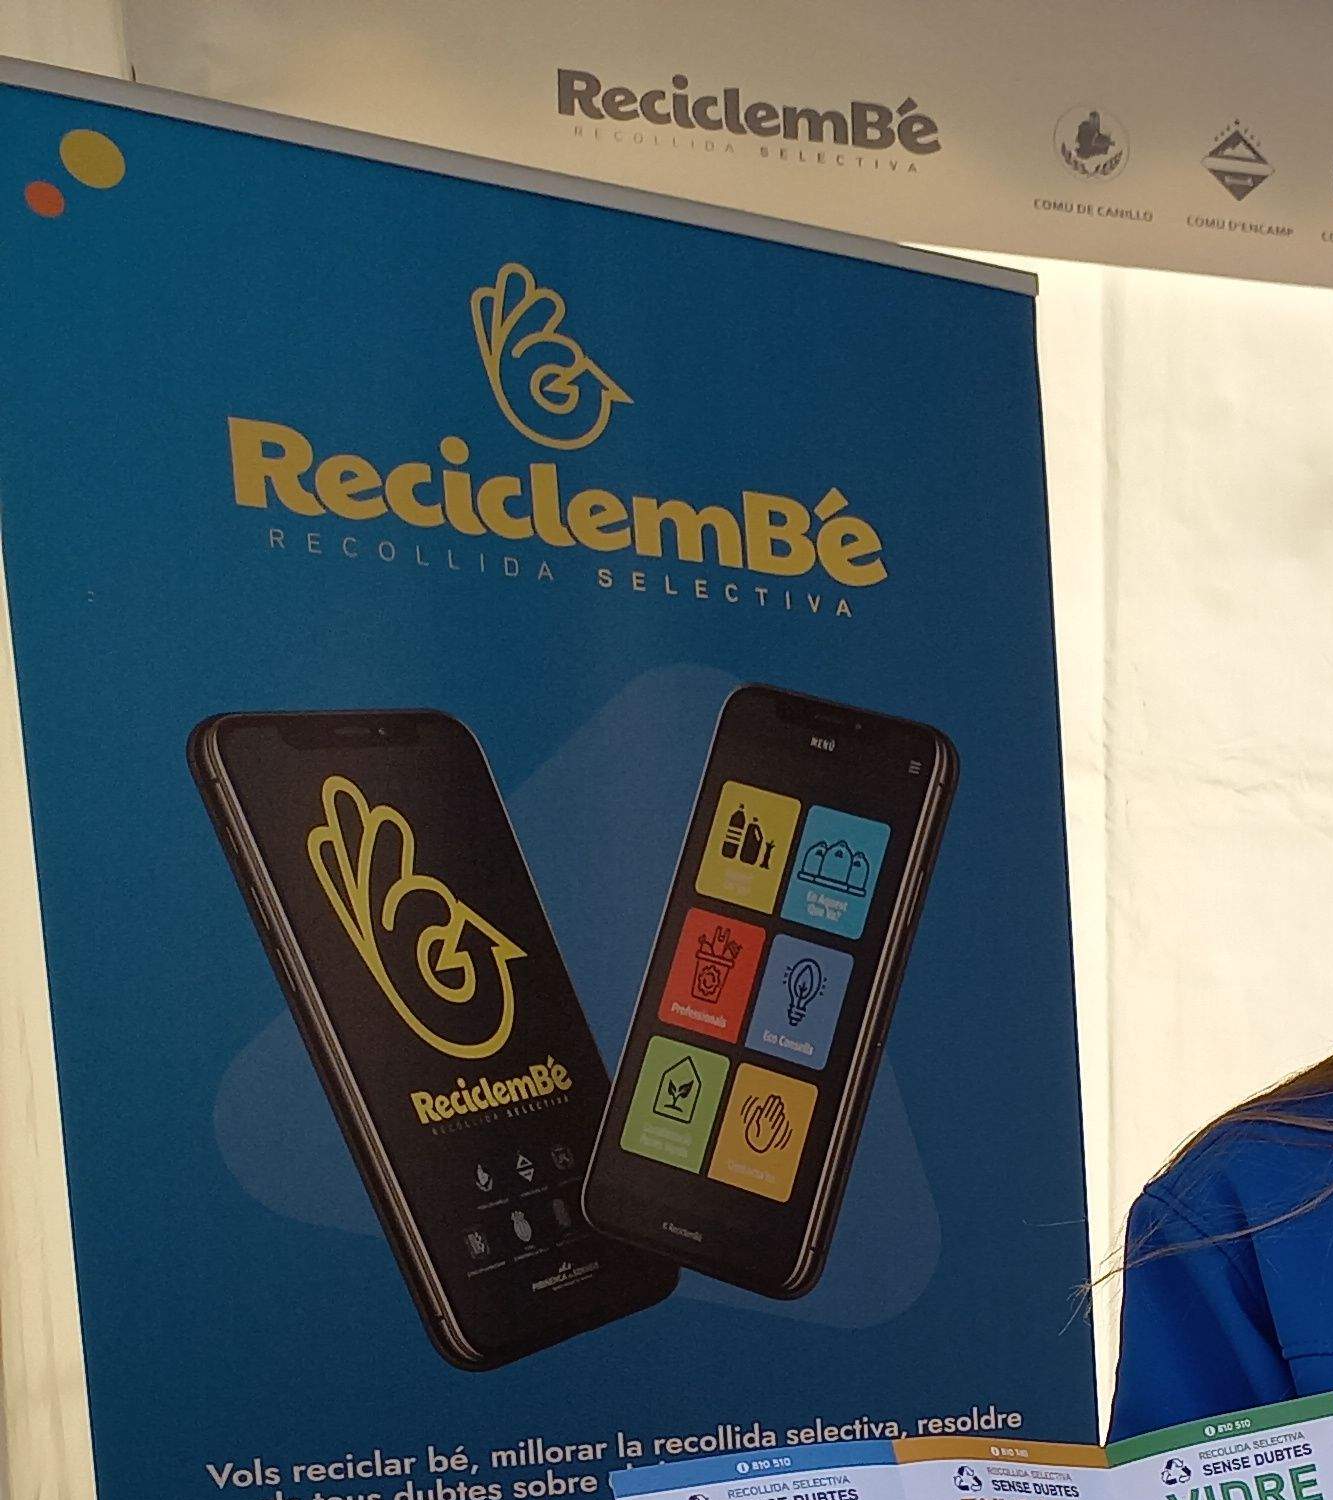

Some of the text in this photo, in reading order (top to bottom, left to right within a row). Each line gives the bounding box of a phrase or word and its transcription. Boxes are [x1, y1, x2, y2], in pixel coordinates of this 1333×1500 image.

[558, 68, 941, 155] ReciclemBé
[574, 125, 919, 174] RECOLLIDA SELECTIVA
[228, 416, 888, 586] ReciclemBé
[270, 528, 851, 617] RECOLLIDA SELECTIVA
[671, 1002, 727, 1028] Professionals
[763, 1030, 779, 1045] Eco
[411, 1055, 572, 1124] ReciclemBé
[206, 1405, 1022, 1490] Vols reciclar bé, millorar la recollida selectiva, resoldre
[1199, 1431, 1305, 1460] RECOLLIDA SELECTIVA
[1203, 1444, 1312, 1476] SENSE DUBTES
[513, 1470, 598, 1499] sobre
[728, 1476, 850, 1499] RECOLLIDA SELECTIVA
[992, 1480, 1079, 1498] SENSE DUBTES
